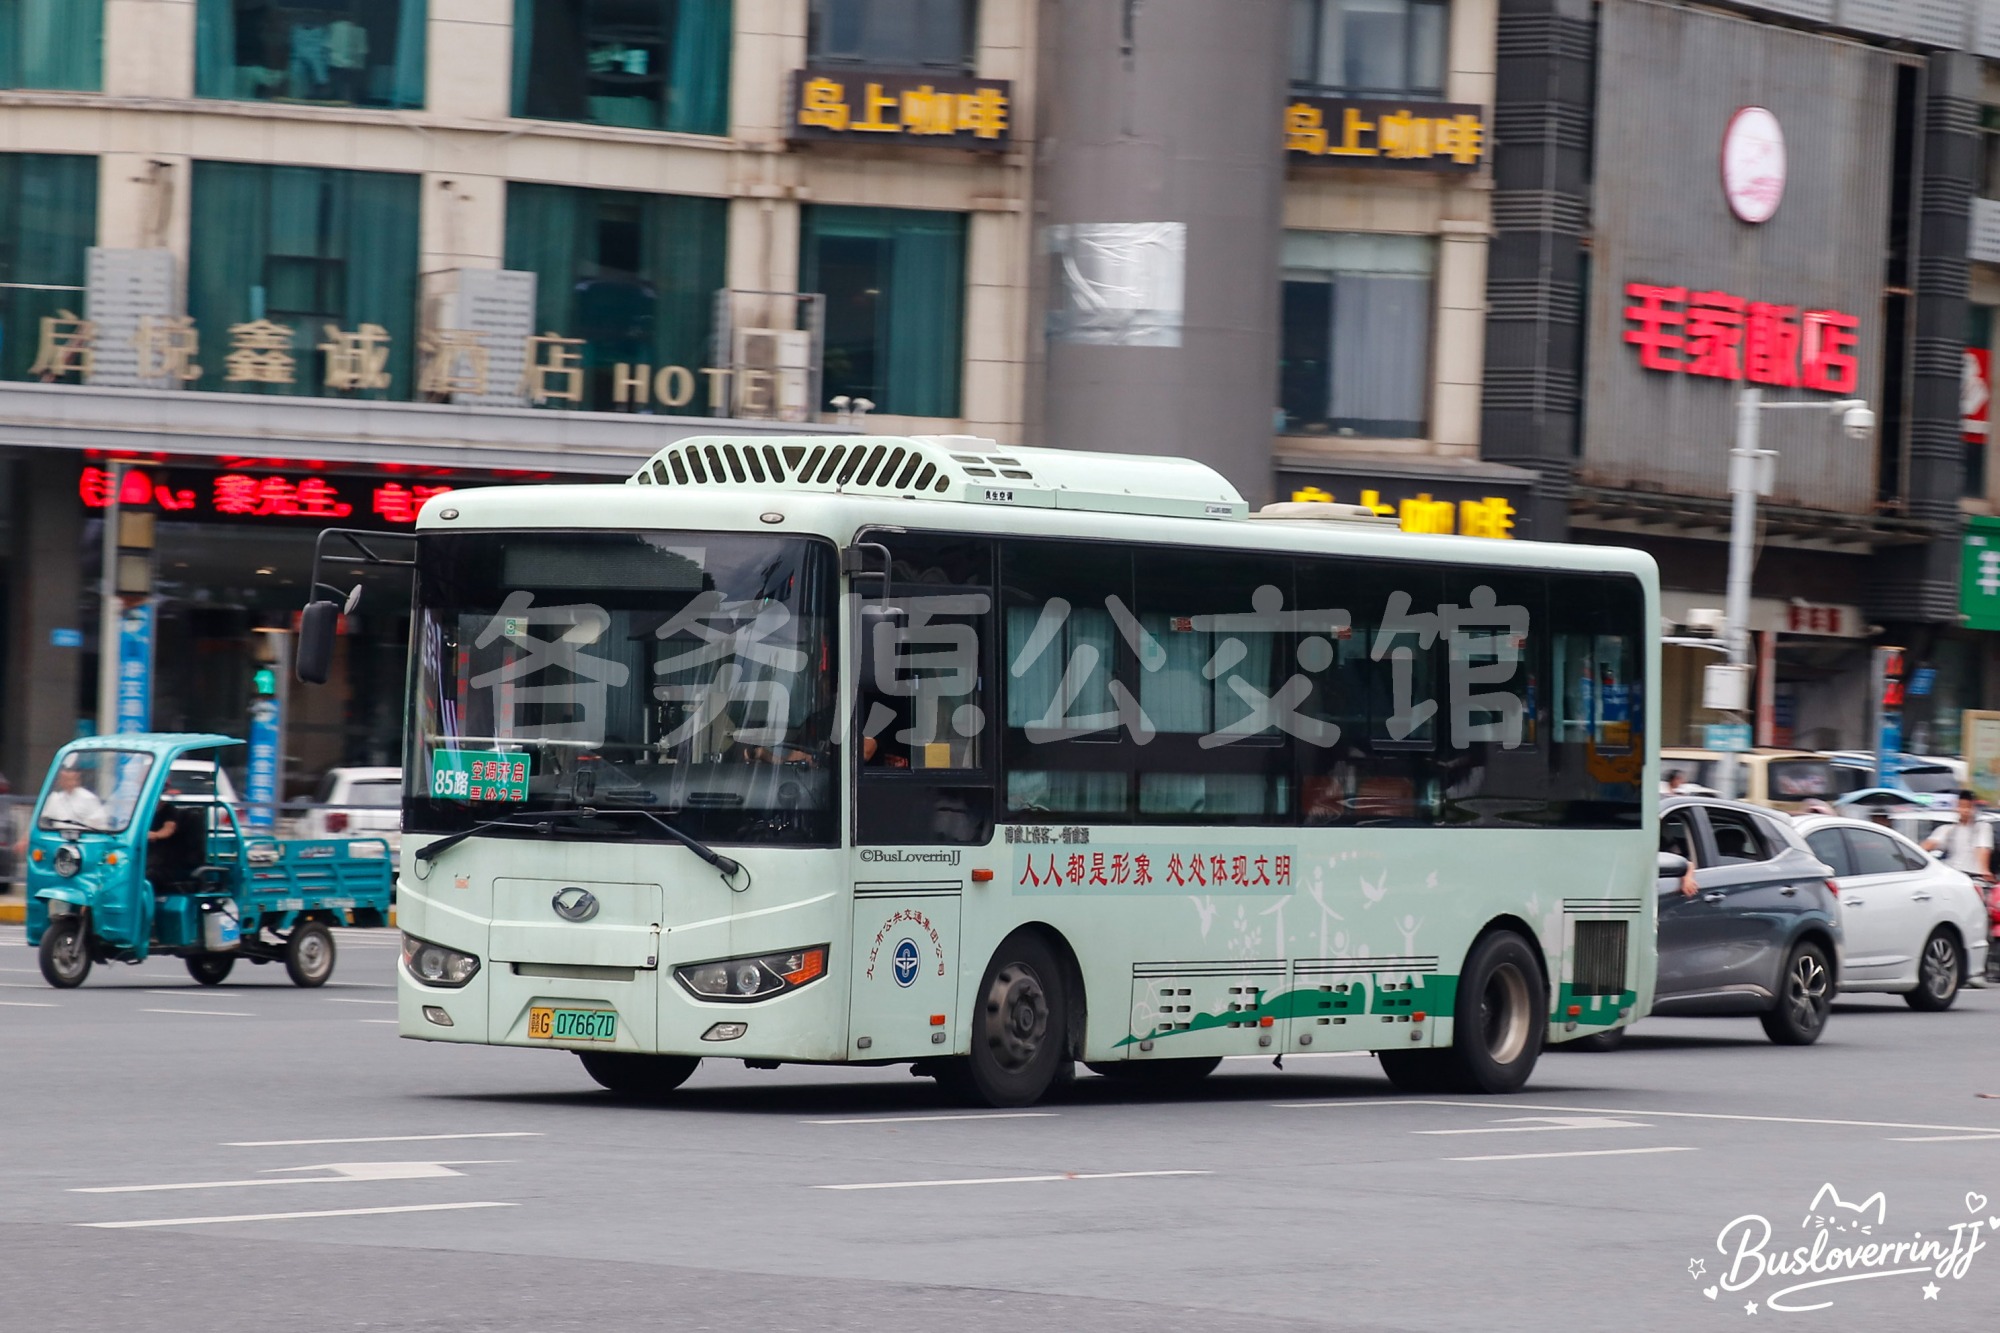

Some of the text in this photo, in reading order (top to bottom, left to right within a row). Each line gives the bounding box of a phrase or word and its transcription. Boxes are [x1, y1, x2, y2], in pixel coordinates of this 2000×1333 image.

[798, 77, 1009, 139] 岛上咖啡
[1284, 103, 1485, 164] 岛上咖啡
[435, 769, 469, 795] 85路
[472, 761, 524, 782] 空调开启
[1019, 852, 1291, 887] 人人都是形象 处处体现文明
